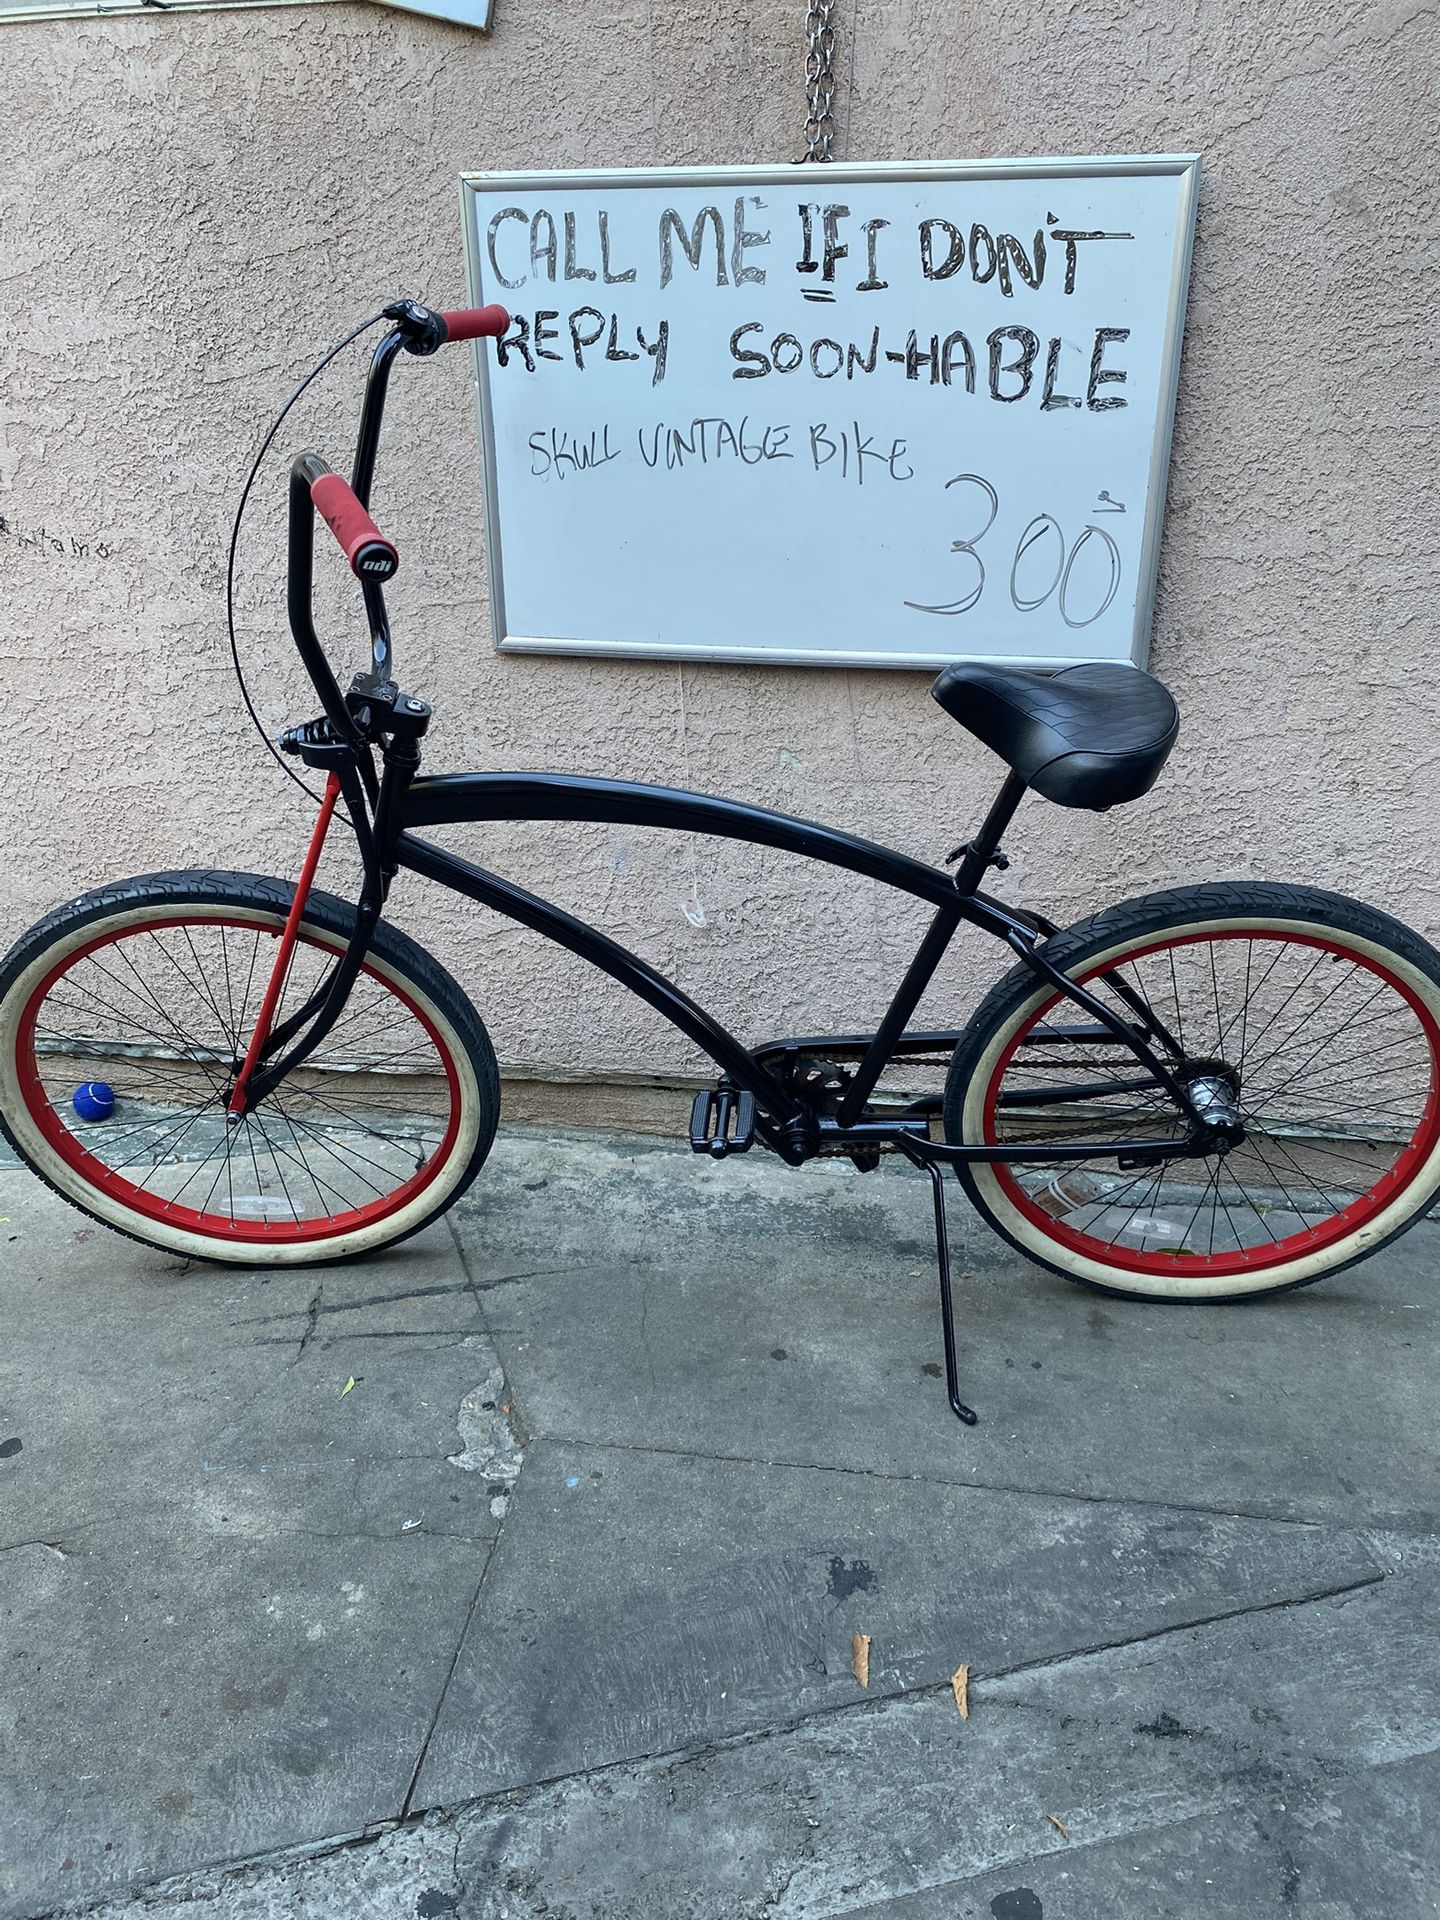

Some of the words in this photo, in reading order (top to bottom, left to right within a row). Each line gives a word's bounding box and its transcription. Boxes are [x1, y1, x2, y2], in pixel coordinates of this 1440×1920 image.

[487, 207, 637, 289] CALL
[659, 196, 771, 288] ME
[796, 203, 850, 283] IF
[855, 219, 891, 291] I
[918, 211, 1135, 298] DON'T
[497, 306, 669, 388] REPLY
[529, 424, 621, 480] SKULL
[639, 416, 794, 470] VINTAGE
[809, 421, 914, 485] BIKE
